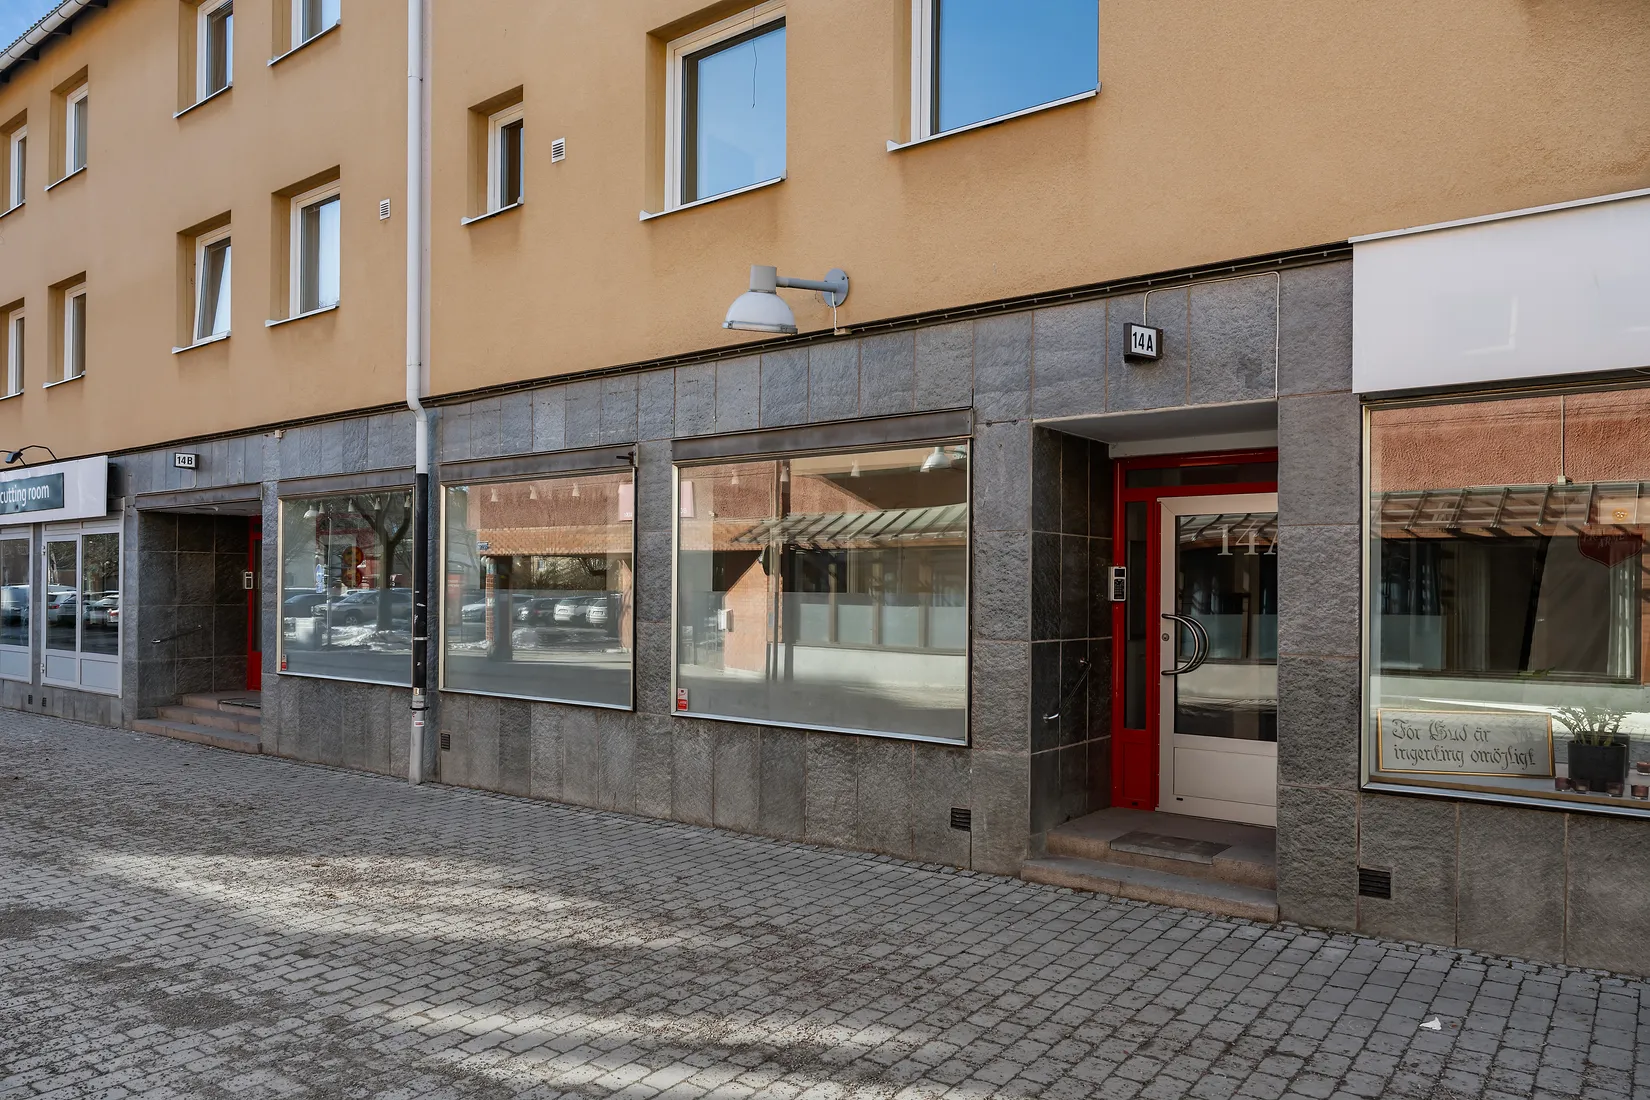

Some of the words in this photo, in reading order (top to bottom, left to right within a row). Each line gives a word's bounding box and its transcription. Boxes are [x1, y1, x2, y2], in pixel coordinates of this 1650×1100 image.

[1132, 331, 1153, 352] 14A
[177, 456, 193, 465] 14B
[0, 485, 27, 507] cutting
[28, 484, 50, 501] room
[1391, 718, 1422, 741] För
[1428, 719, 1468, 742] Gud
[1473, 727, 1492, 743] är
[1393, 744, 1465, 768] ingenting
[1470, 746, 1536, 770] omöjligt
